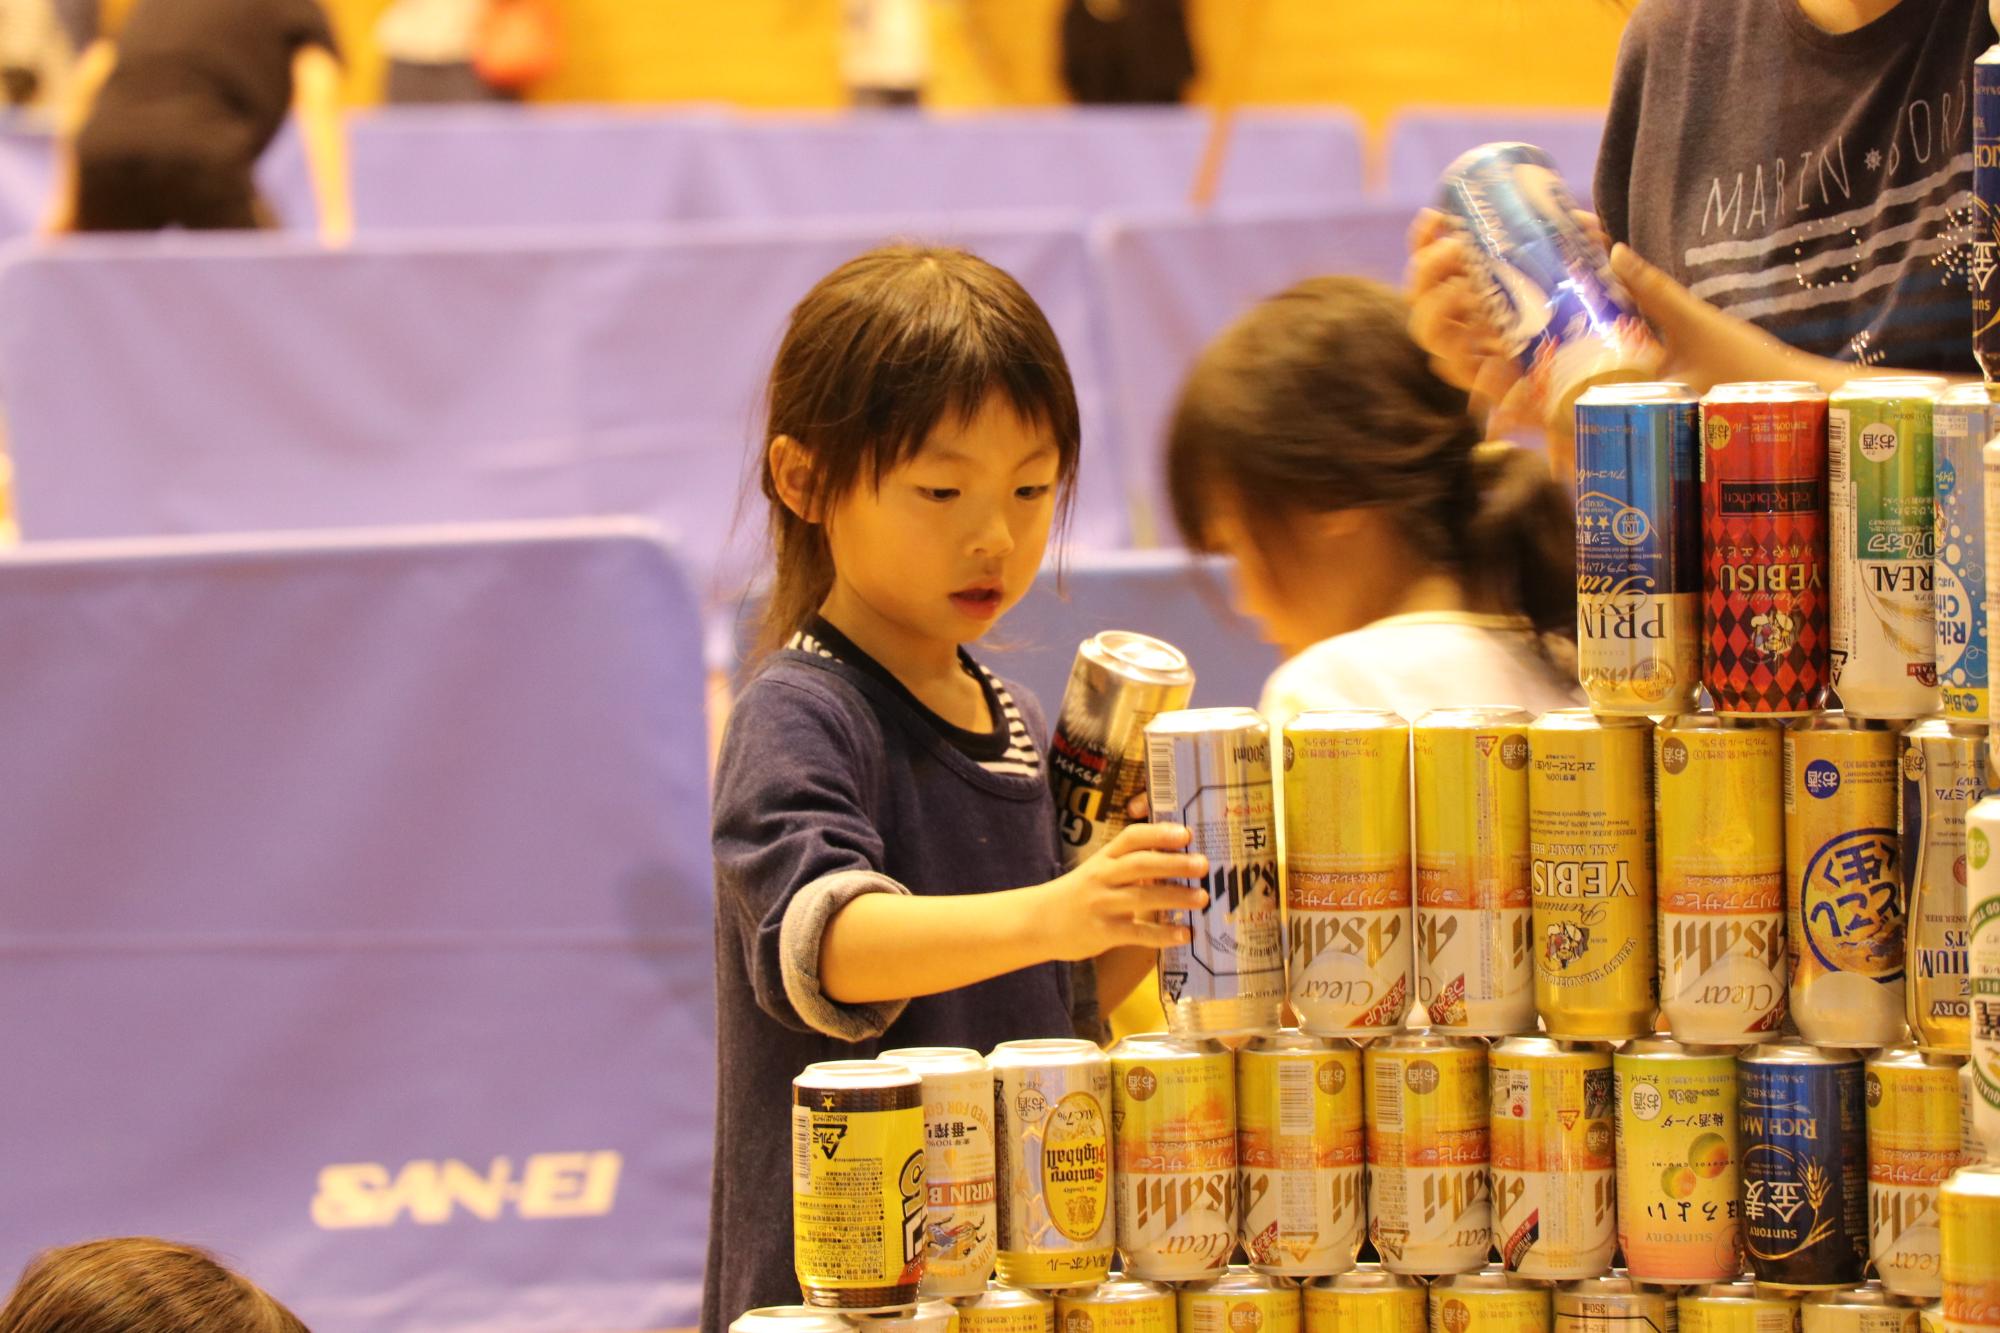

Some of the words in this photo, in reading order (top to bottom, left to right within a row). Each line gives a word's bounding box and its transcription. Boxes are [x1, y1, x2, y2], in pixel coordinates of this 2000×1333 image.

[1701, 137, 1851, 236] MARIN
[1863, 433, 1896, 450] お酒
[1719, 563, 1821, 592] YEBISU
[1907, 664, 1936, 674] VALU
[1663, 746, 1687, 766] お酒
[1807, 769, 1838, 789] お酒
[1243, 827, 1266, 851] 生
[1294, 888, 1387, 906] クリアアサヒ
[1672, 918, 1786, 977] Asahi
[1300, 980, 1374, 1007] Clear
[1694, 984, 1774, 1012] Clear
[1931, 1001, 1969, 1017] ORY
[1127, 1075, 1155, 1092] お酒
[1318, 1069, 1346, 1086] お酒
[1407, 1069, 1438, 1084] お酒
[1017, 1096, 1046, 1113] お酒
[1633, 1091, 1660, 1111] お酒
[1660, 1112, 1725, 1129] 梅酒ソーダ
[812, 1132, 835, 1145] アルミ
[1046, 1143, 1106, 1170] Highball
[1050, 1165, 1105, 1184] Suntory
[950, 1181, 995, 1204] KIRIN
[1137, 1173, 1238, 1231] Asahi
[1744, 1178, 1805, 1223] 金麦
[1647, 1201, 1739, 1222] ほろよい
[1158, 1232, 1231, 1261] Clear
[1645, 1232, 1713, 1244] SUNTORY
[1231, 1310, 1258, 1327] お酒
[1444, 1307, 1469, 1323] お酒
